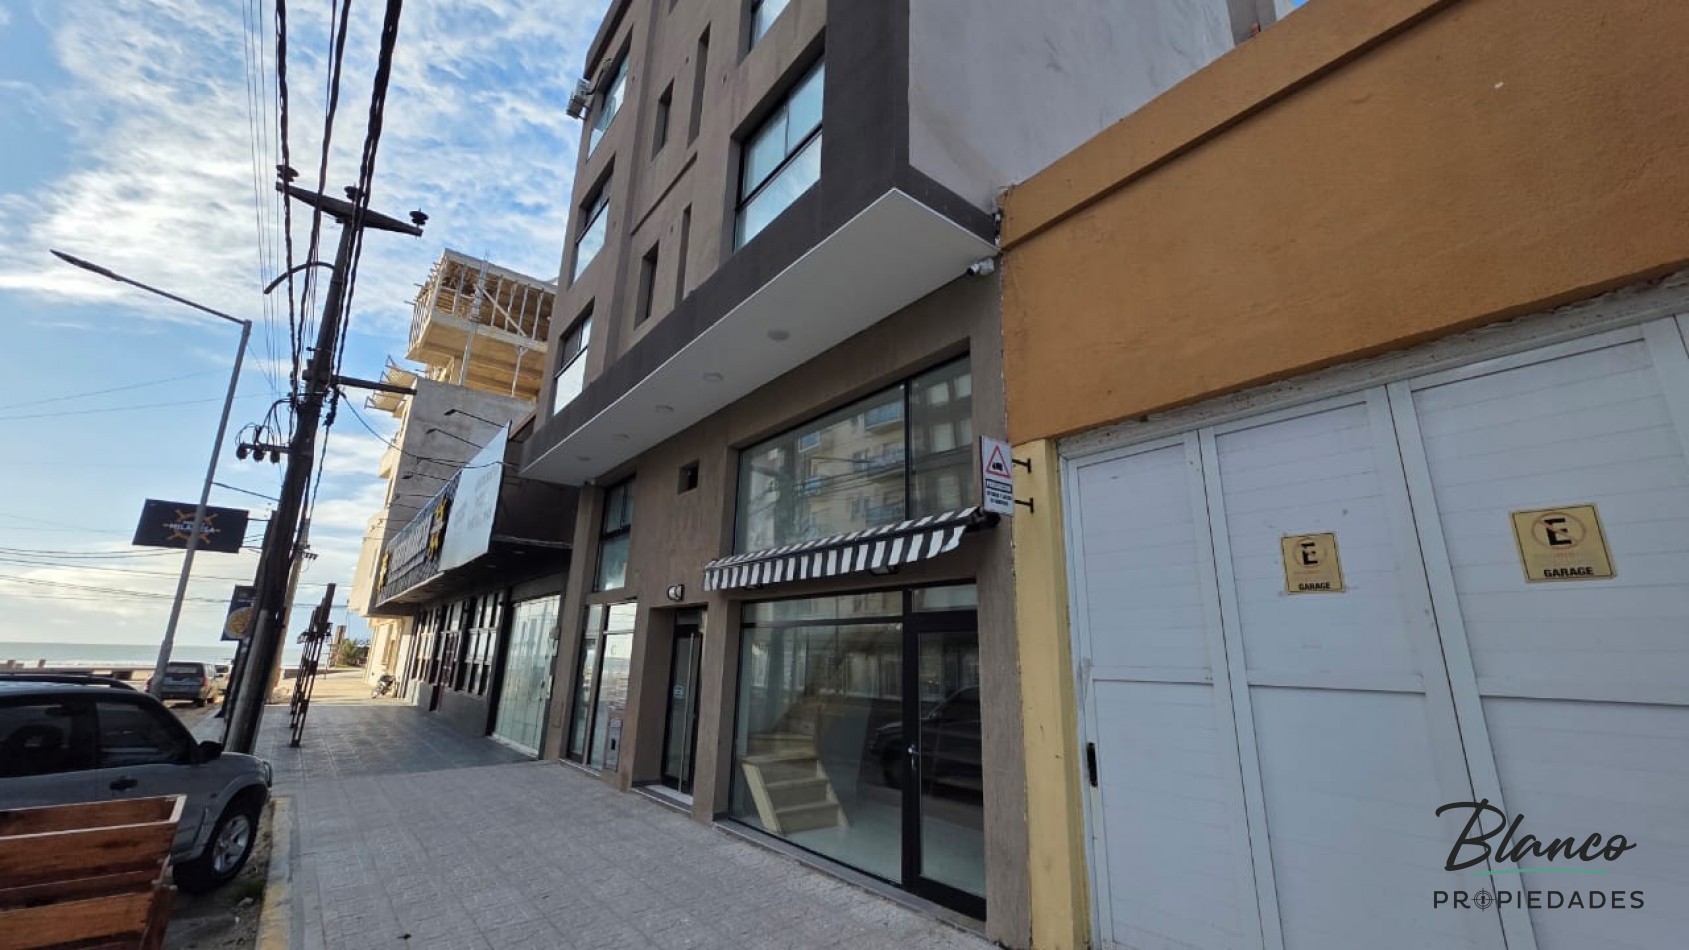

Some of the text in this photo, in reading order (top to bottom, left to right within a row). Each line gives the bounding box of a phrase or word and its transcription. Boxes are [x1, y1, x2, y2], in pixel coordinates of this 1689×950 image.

[1544, 518, 1572, 545] E
[1301, 542, 1318, 565] E
[1544, 566, 1594, 578] GARAGE
[1298, 582, 1331, 591] GARAGE
